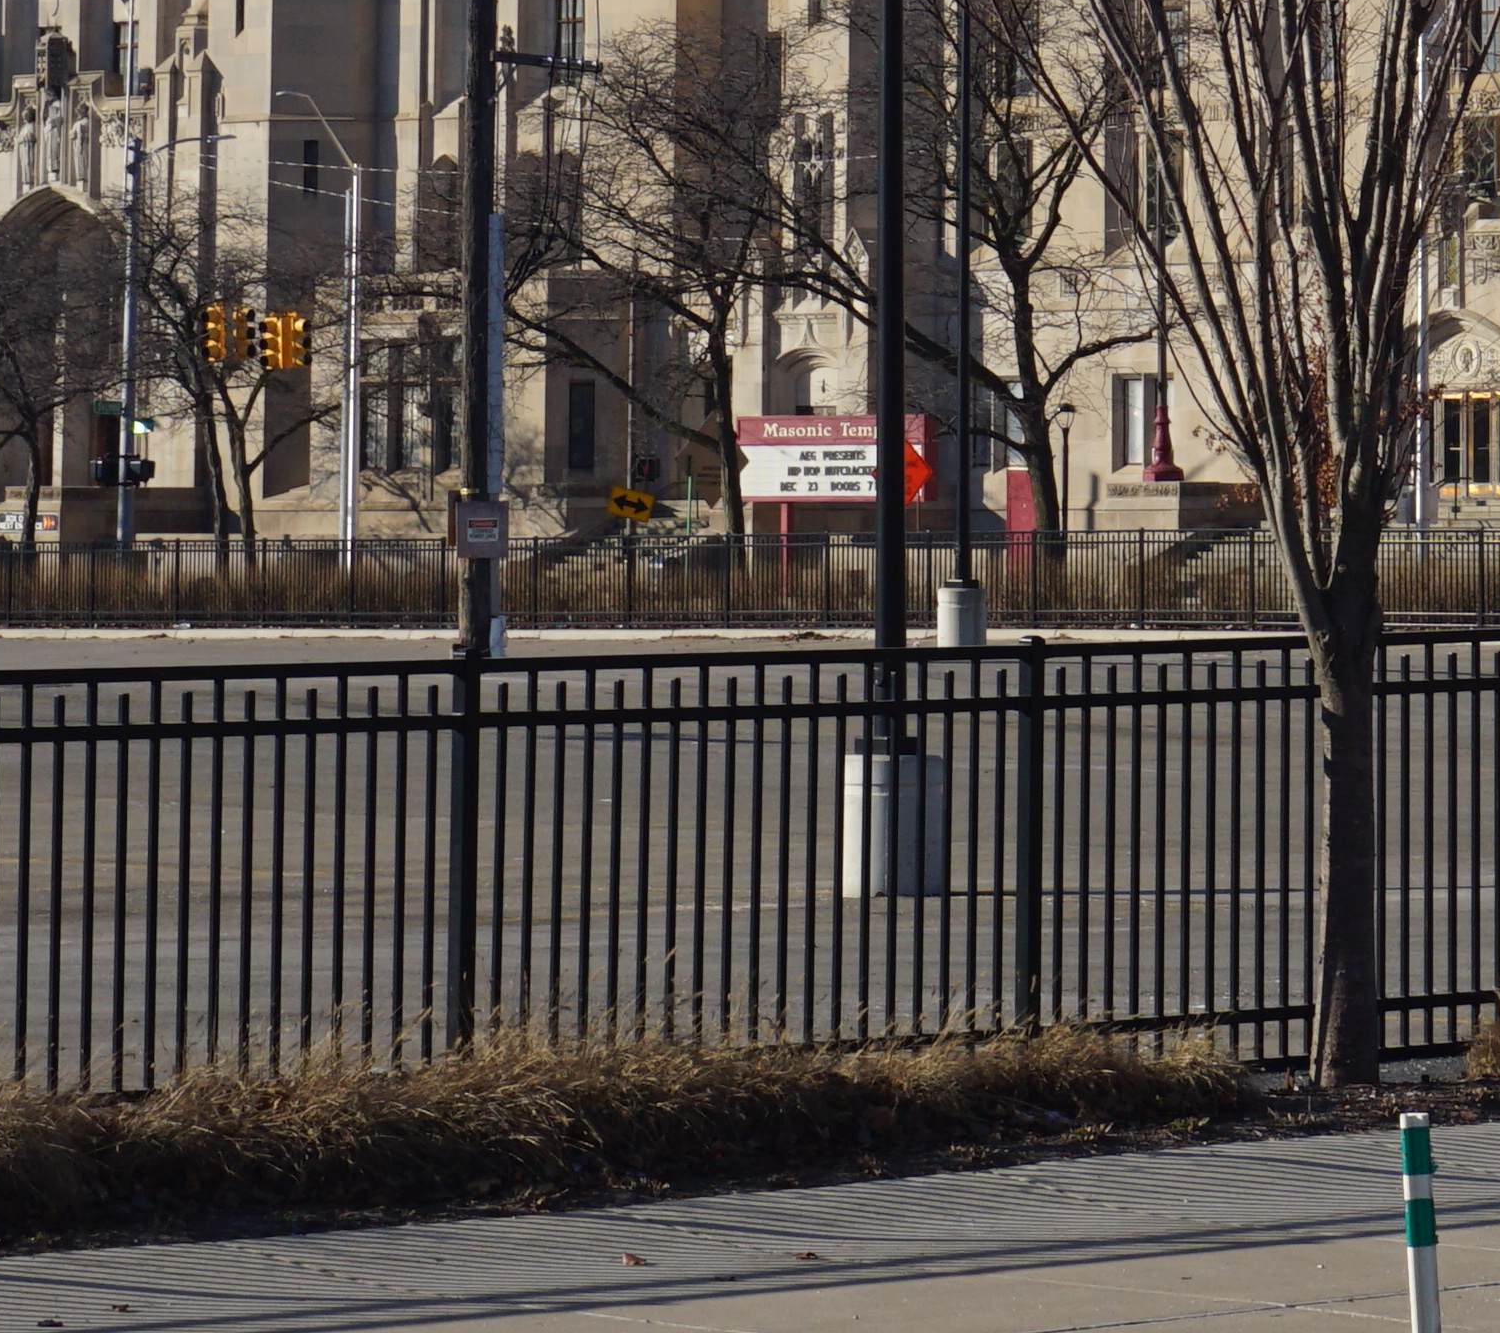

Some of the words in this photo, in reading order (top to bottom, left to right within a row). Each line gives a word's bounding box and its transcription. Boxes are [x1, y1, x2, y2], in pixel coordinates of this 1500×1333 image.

[762, 422, 832, 438] Masonic
[799, 451, 817, 461] AEG
[823, 451, 867, 461] PRESENTS
[787, 466, 802, 476] HIP
[804, 466, 821, 476] HOP
[780, 482, 797, 492] DEC
[808, 482, 819, 492] 23
[831, 482, 861, 492] DOORS
